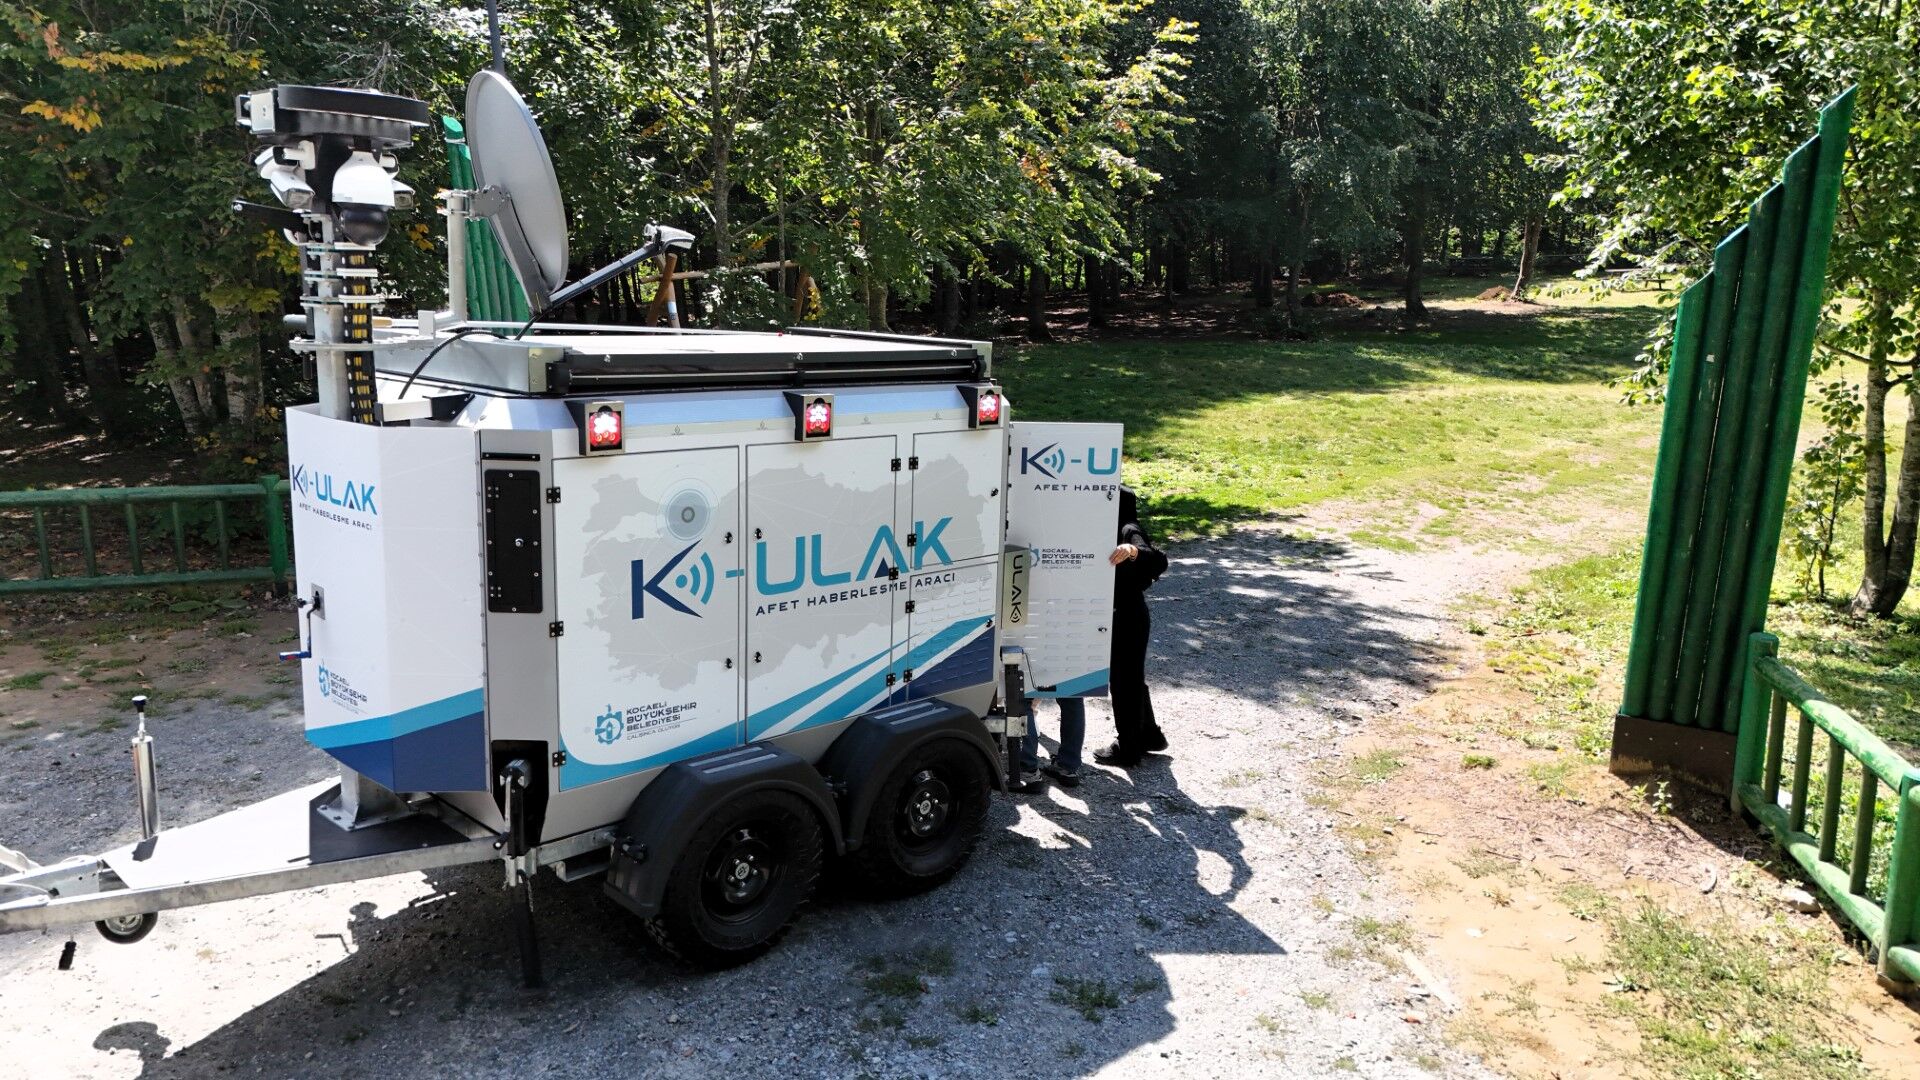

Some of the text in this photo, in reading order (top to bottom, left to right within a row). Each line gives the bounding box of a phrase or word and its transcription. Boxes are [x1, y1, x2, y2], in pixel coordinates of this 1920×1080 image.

[755, 573, 956, 616] AFET HABERLEŞME ARACI
[626, 701, 668, 715] KOCAELİ
[626, 714, 681, 732] BELEDİYESİ
